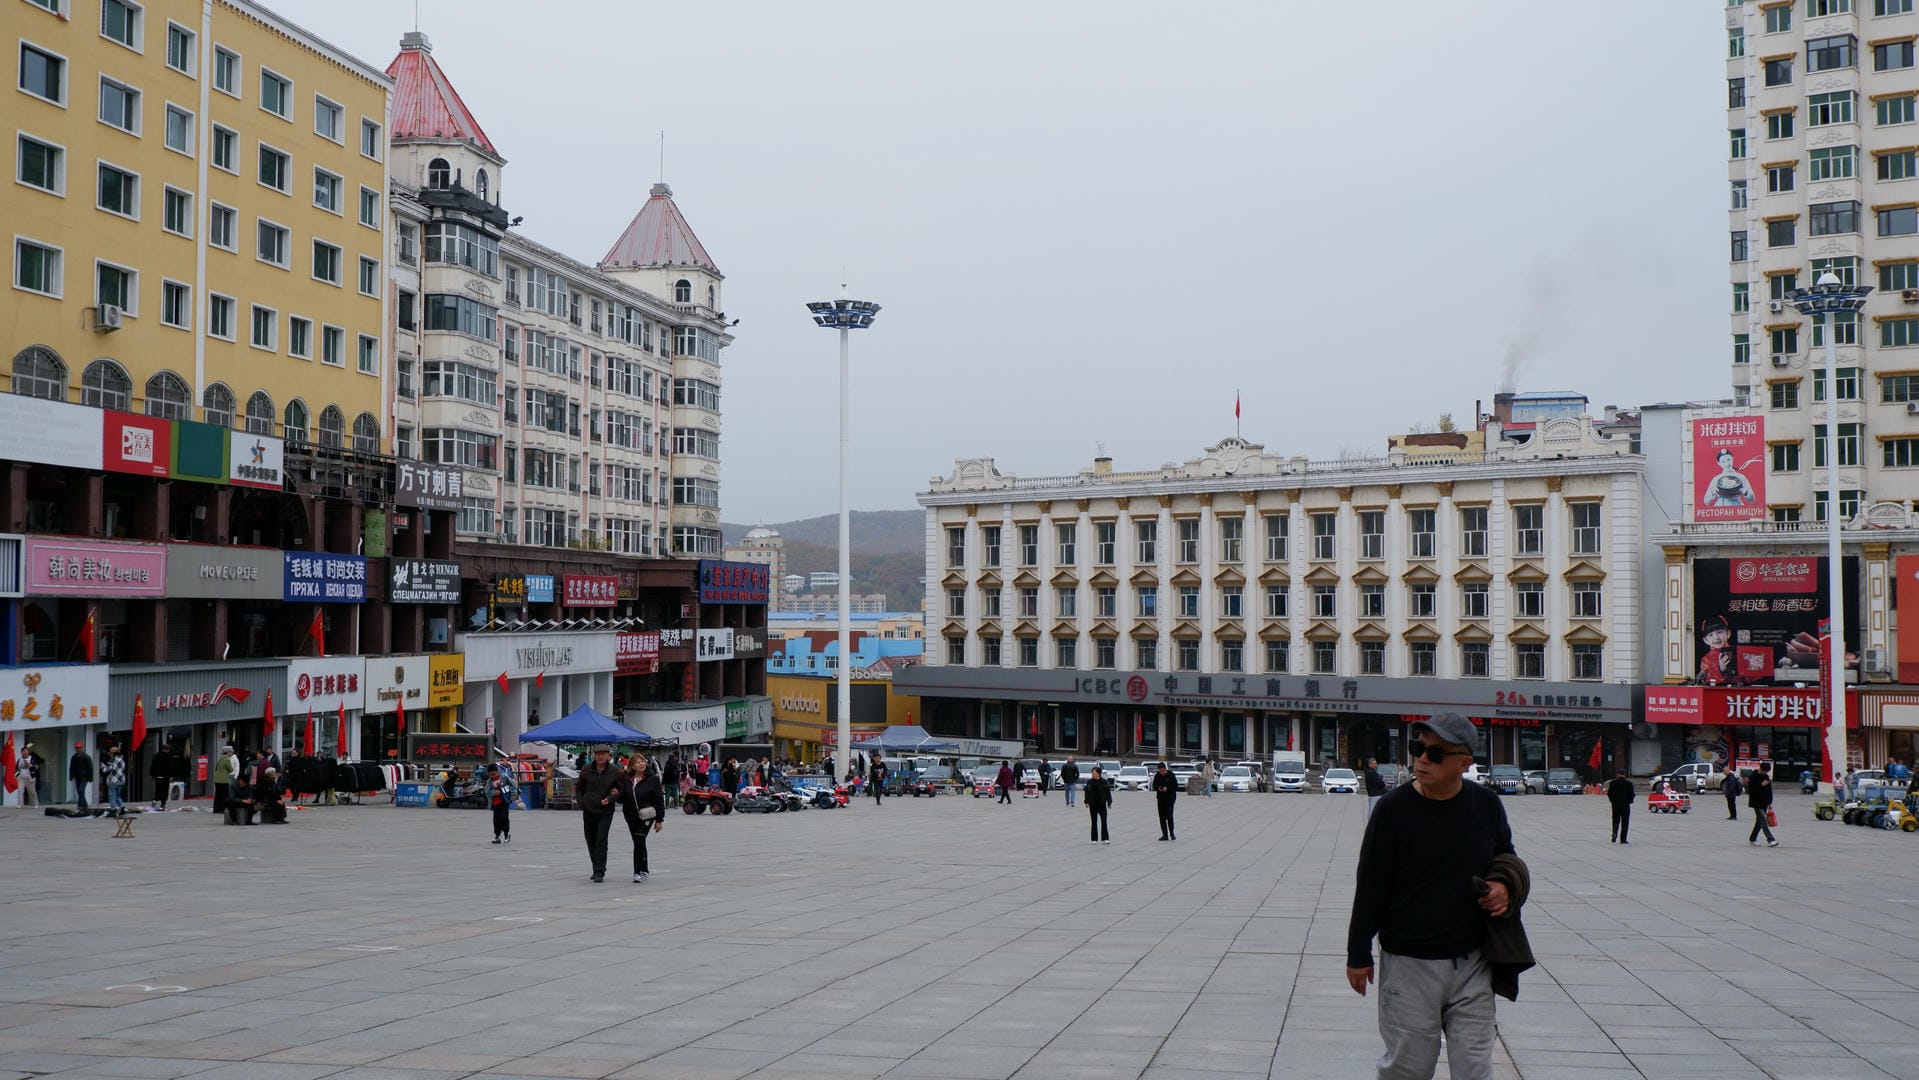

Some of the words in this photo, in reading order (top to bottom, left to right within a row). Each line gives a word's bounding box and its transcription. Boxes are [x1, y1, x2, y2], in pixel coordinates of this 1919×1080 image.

[1701, 422, 1757, 437] 米村拌饭
[134, 432, 152, 450] 完美
[400, 464, 461, 498] 方寸刺青
[1697, 508, 1734, 517] РЕСТОРАН
[1737, 507, 1764, 518] МИЦУН
[50, 555, 113, 581] 韩尚美妆
[291, 558, 323, 579] 毛线城
[326, 559, 365, 580] 时尚女装
[290, 582, 321, 597] ПРЯЖА
[392, 590, 438, 601] СПЕЦМАГАЗИН
[1728, 598, 1769, 612] 爱相连
[1075, 678, 1121, 696] ICBC
[1165, 675, 1359, 699] 中国工商银行
[156, 692, 211, 710] LI-NING
[780, 690, 820, 713] balabala
[1496, 690, 1527, 705] 24h
[671, 717, 718, 734] GIORDANO
